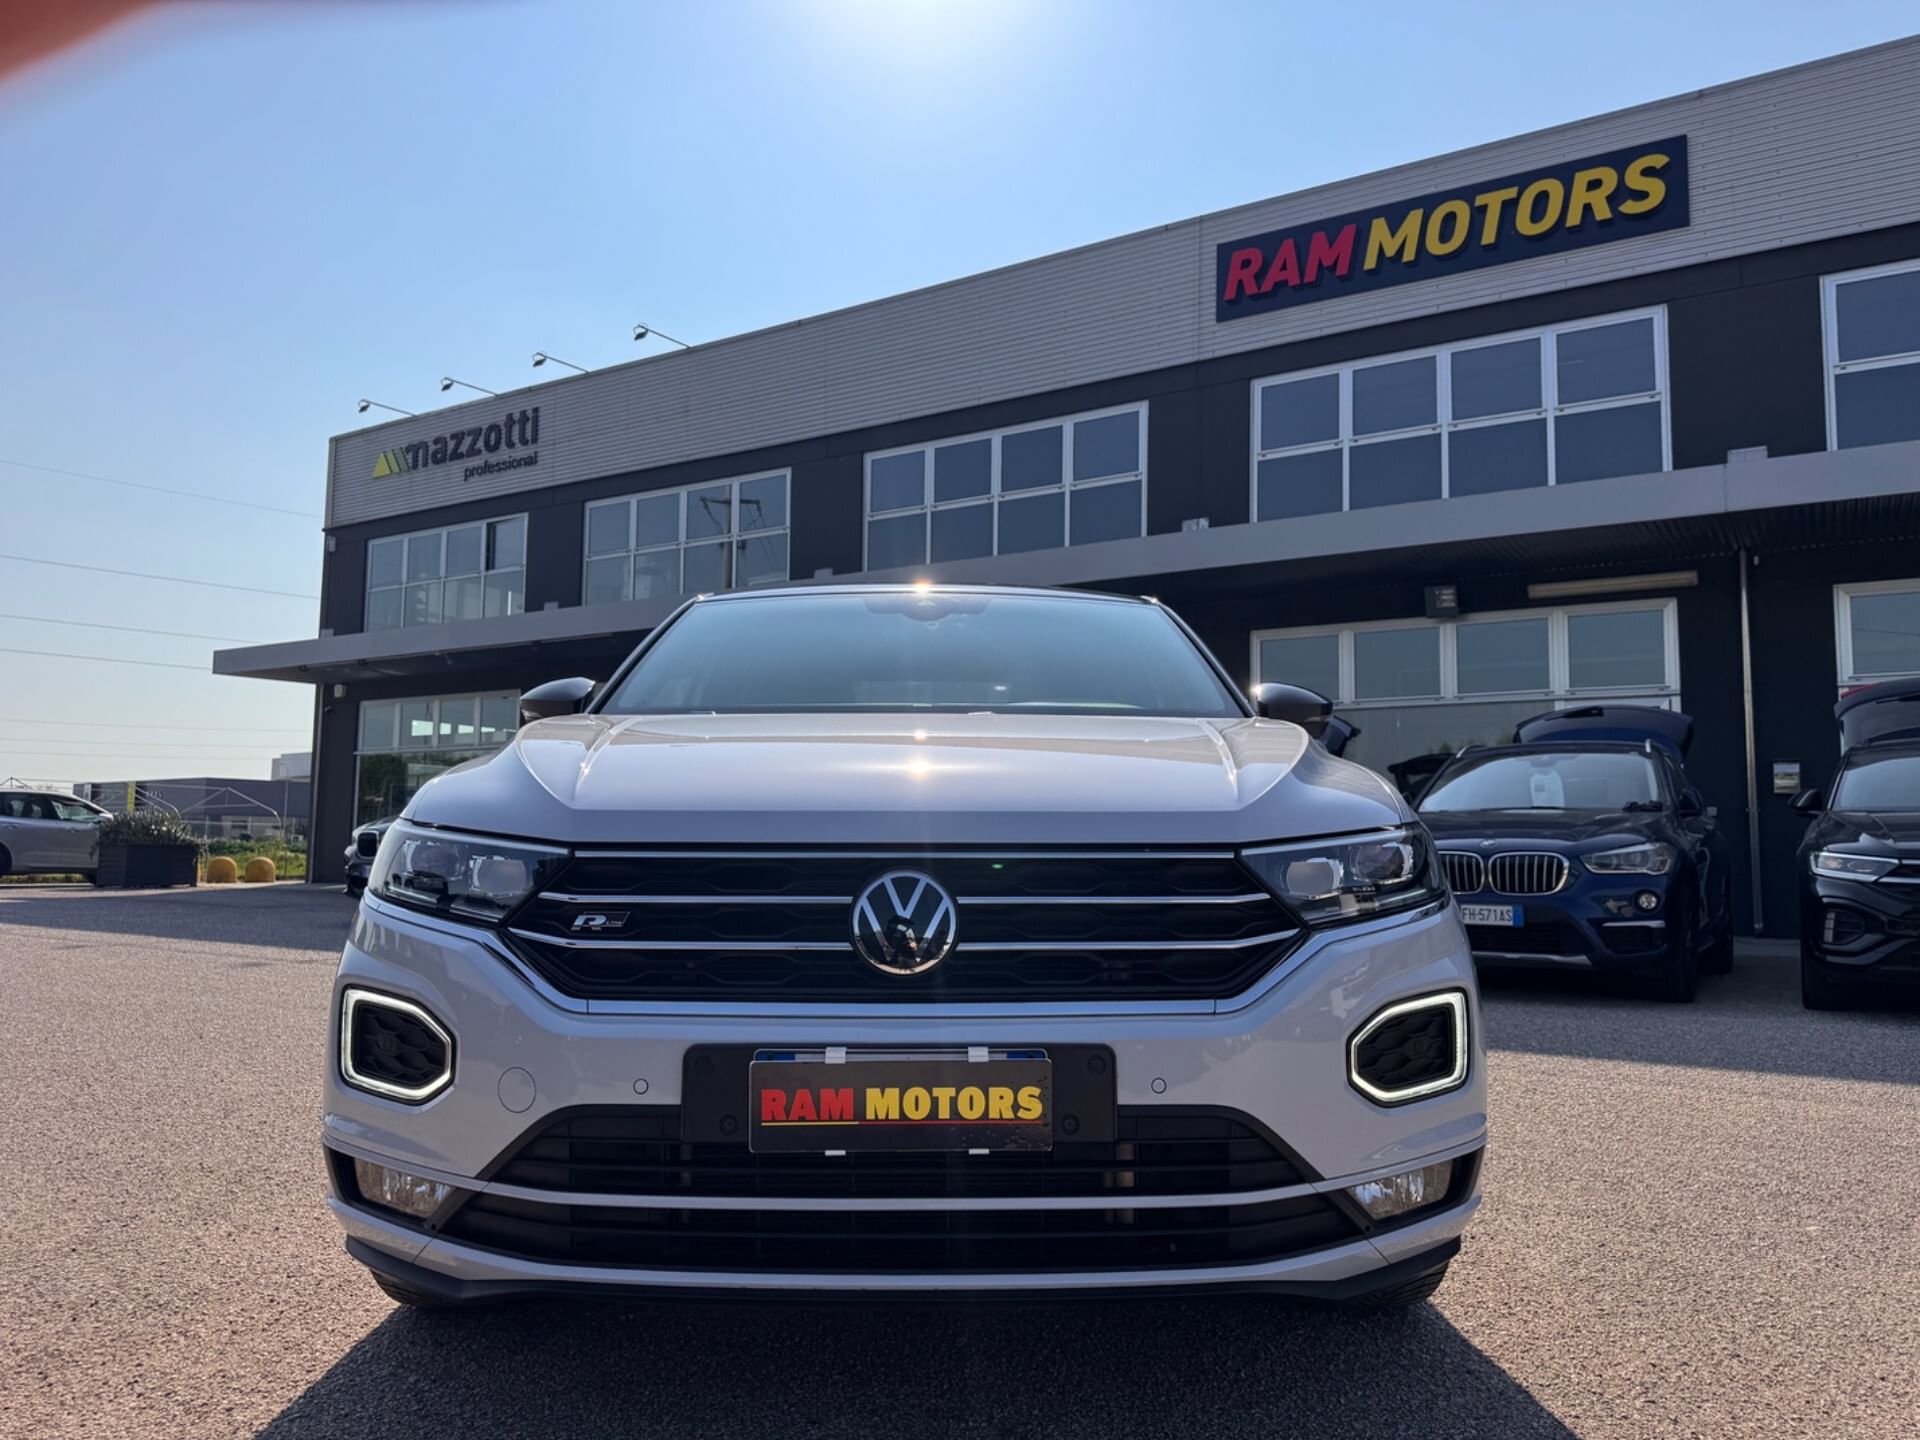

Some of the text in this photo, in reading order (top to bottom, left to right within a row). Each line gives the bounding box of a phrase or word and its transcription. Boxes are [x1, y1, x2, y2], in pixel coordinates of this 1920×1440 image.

[1223, 153, 1670, 301] RAM MOTORS
[404, 406, 540, 471] mazzotti
[463, 451, 538, 482] professional
[760, 1086, 1042, 1121] RAM MOTORS
